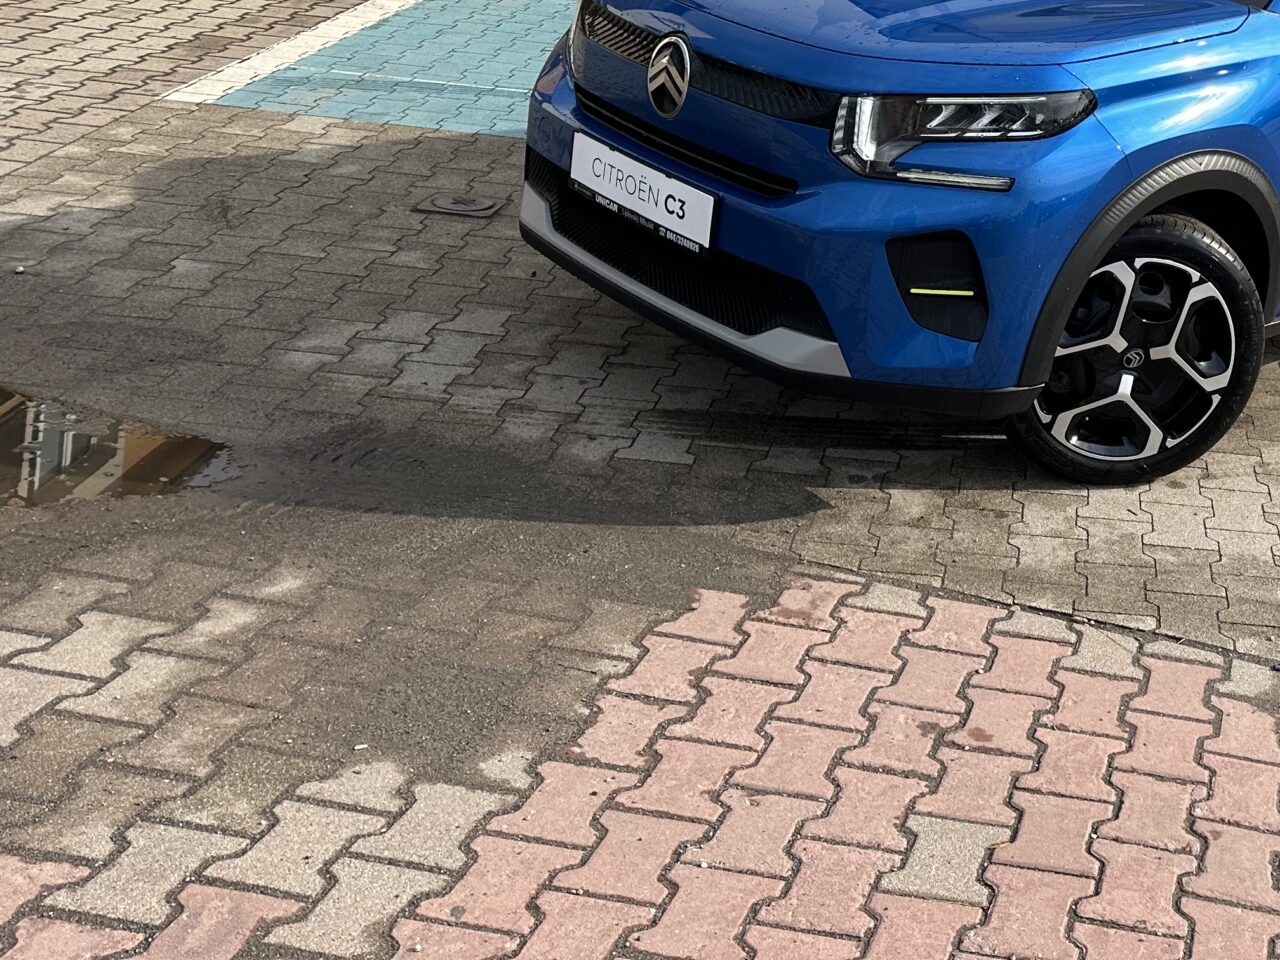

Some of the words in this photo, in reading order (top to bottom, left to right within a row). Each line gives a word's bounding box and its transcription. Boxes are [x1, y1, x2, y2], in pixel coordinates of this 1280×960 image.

[591, 156, 660, 209] CITROËN
[664, 193, 686, 220] C3
[595, 193, 619, 213] UNICAR
